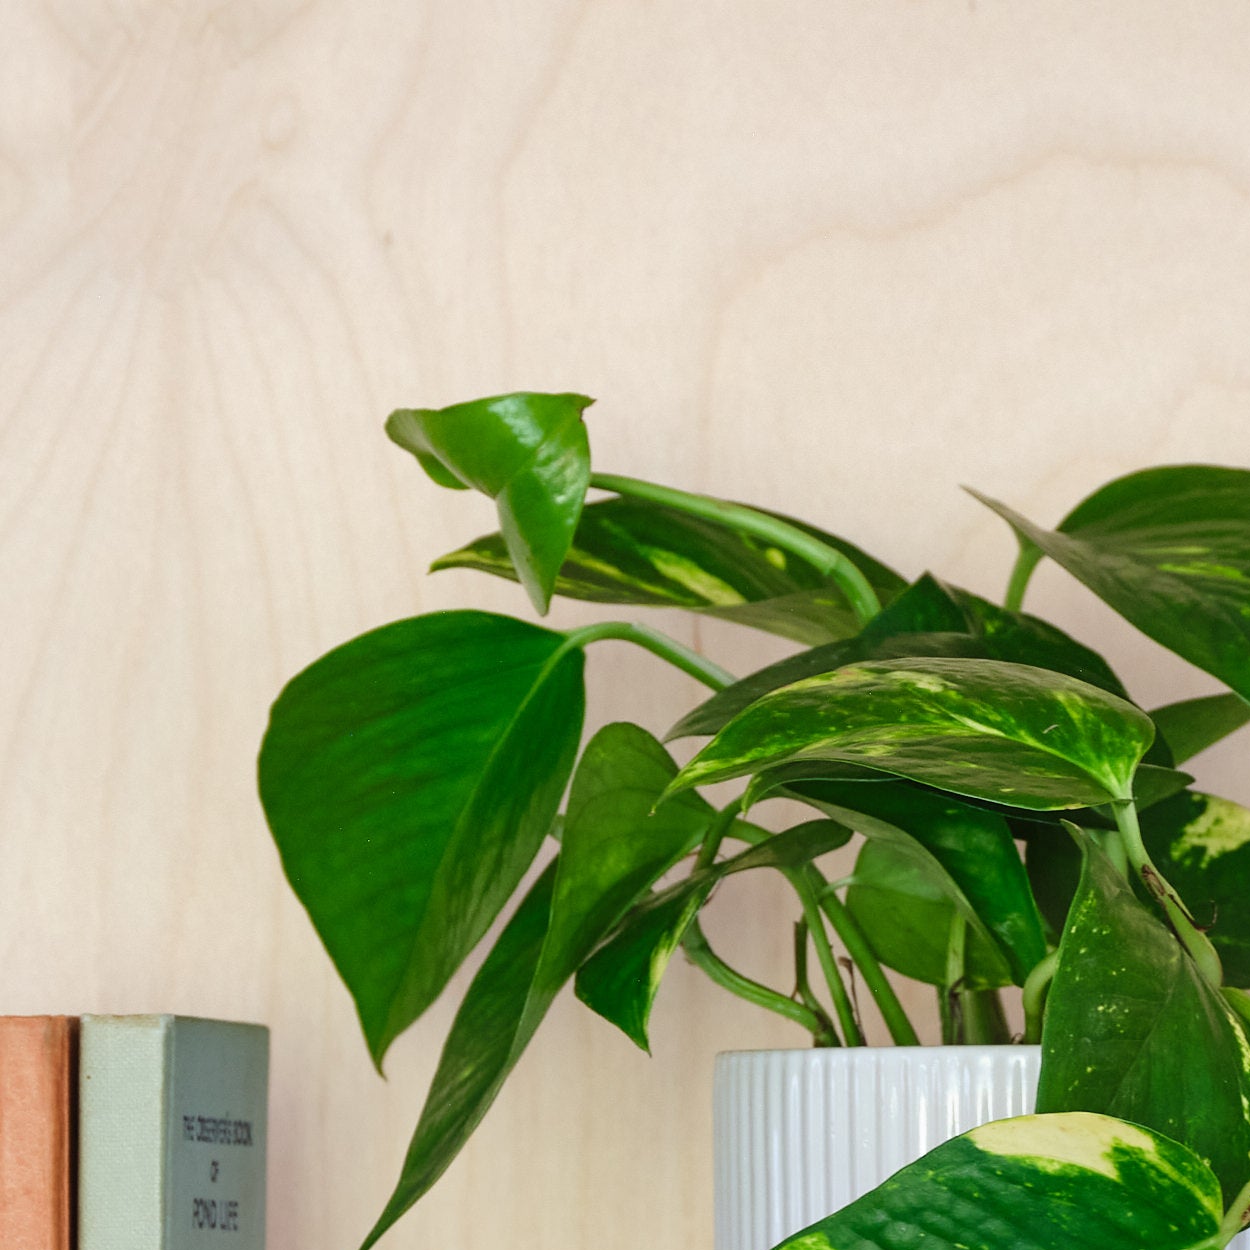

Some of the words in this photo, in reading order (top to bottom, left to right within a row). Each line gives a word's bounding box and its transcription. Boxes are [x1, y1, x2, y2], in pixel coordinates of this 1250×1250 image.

[210, 1160, 219, 1182] OF
[192, 1198, 217, 1230] POND
[219, 1200, 238, 1231] LIFE
